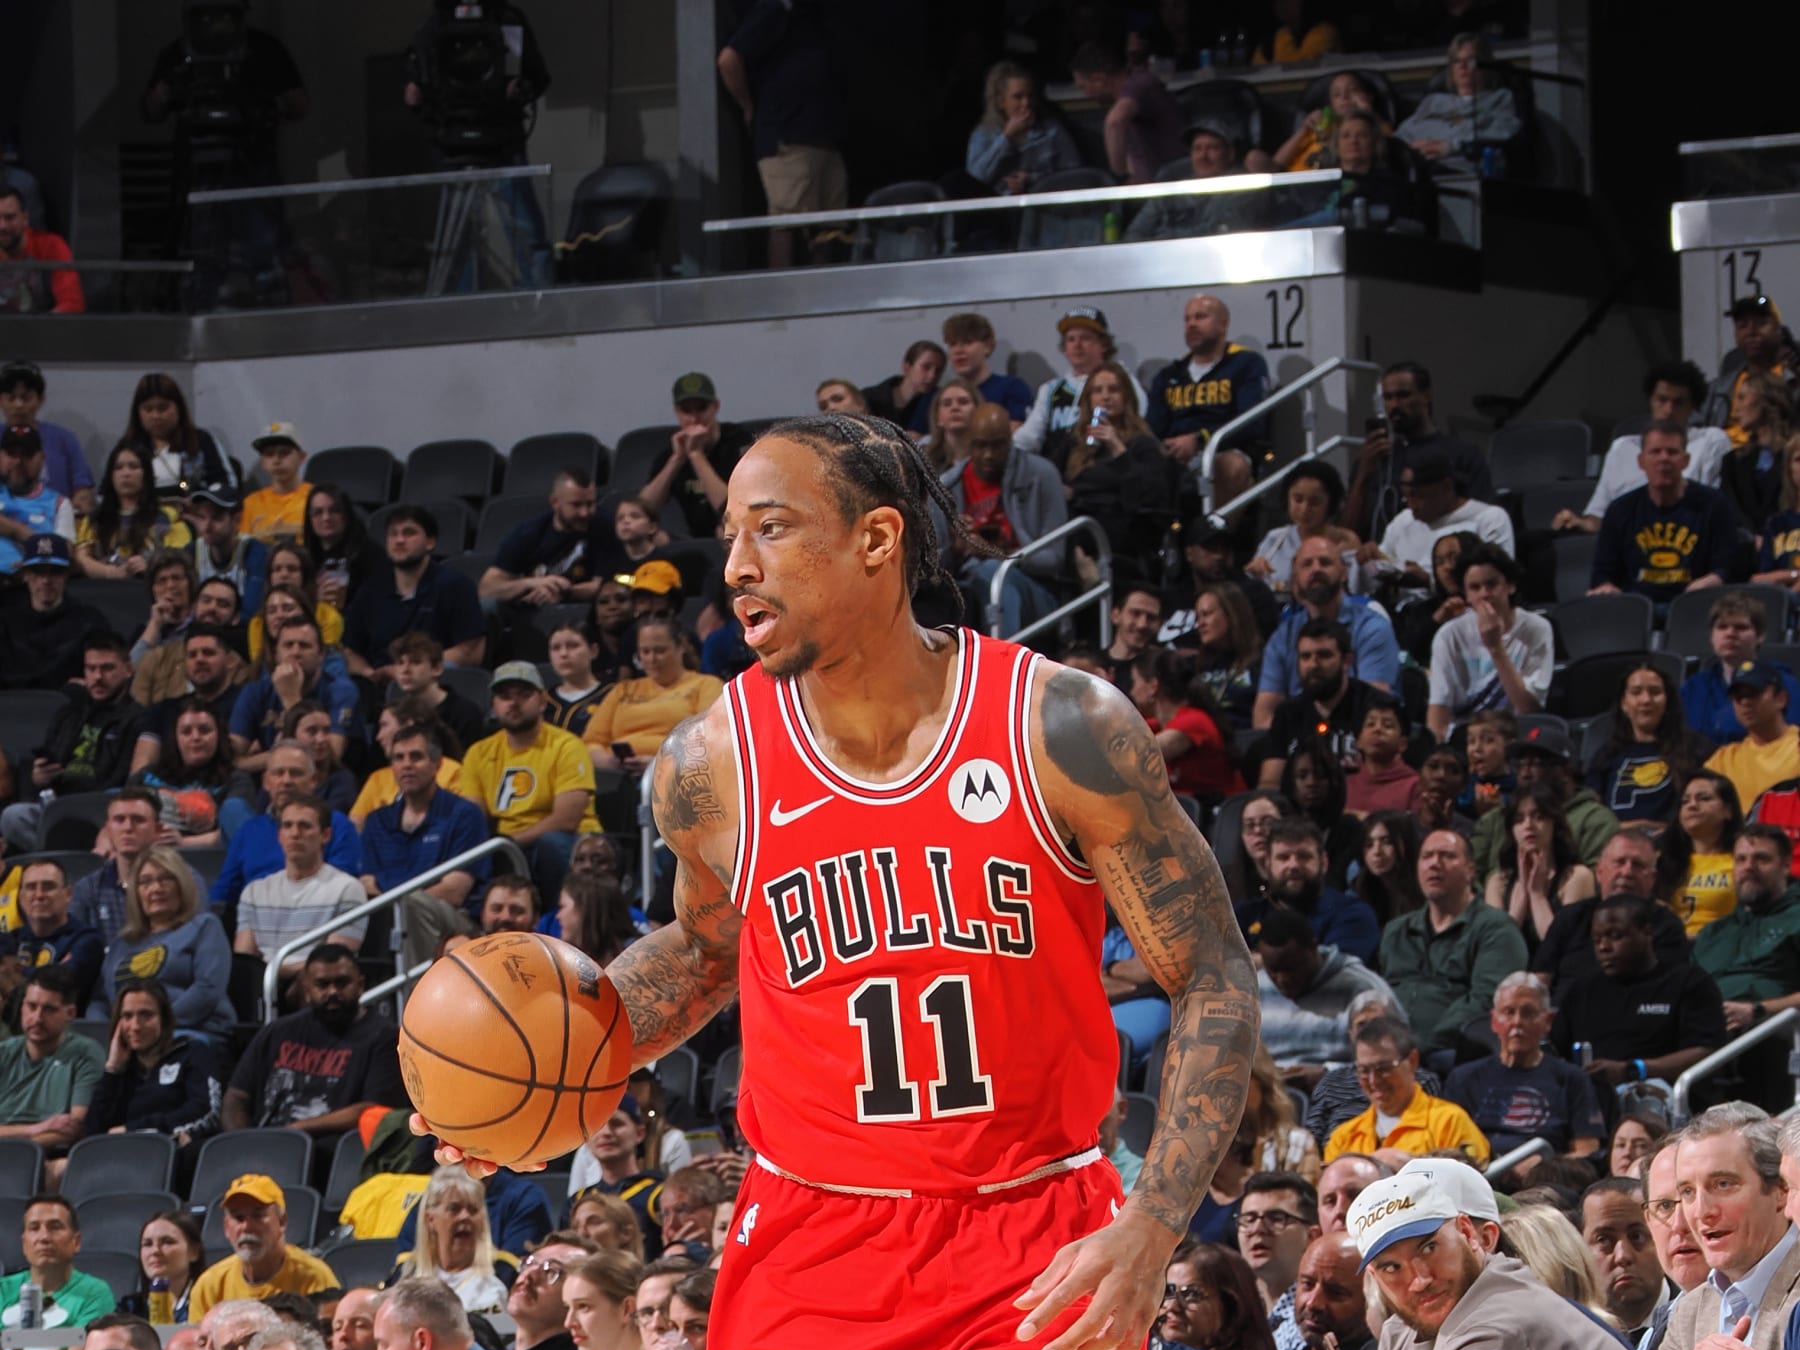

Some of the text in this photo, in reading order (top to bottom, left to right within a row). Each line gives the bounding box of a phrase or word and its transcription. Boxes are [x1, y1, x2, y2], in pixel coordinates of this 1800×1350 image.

[1723, 251, 1762, 303] 13
[1266, 284, 1305, 349] 12
[1165, 379, 1232, 410] PACERS
[762, 846, 1036, 989] BULLS
[847, 975, 995, 1124] 11
[1354, 1196, 1416, 1233] Pacers
